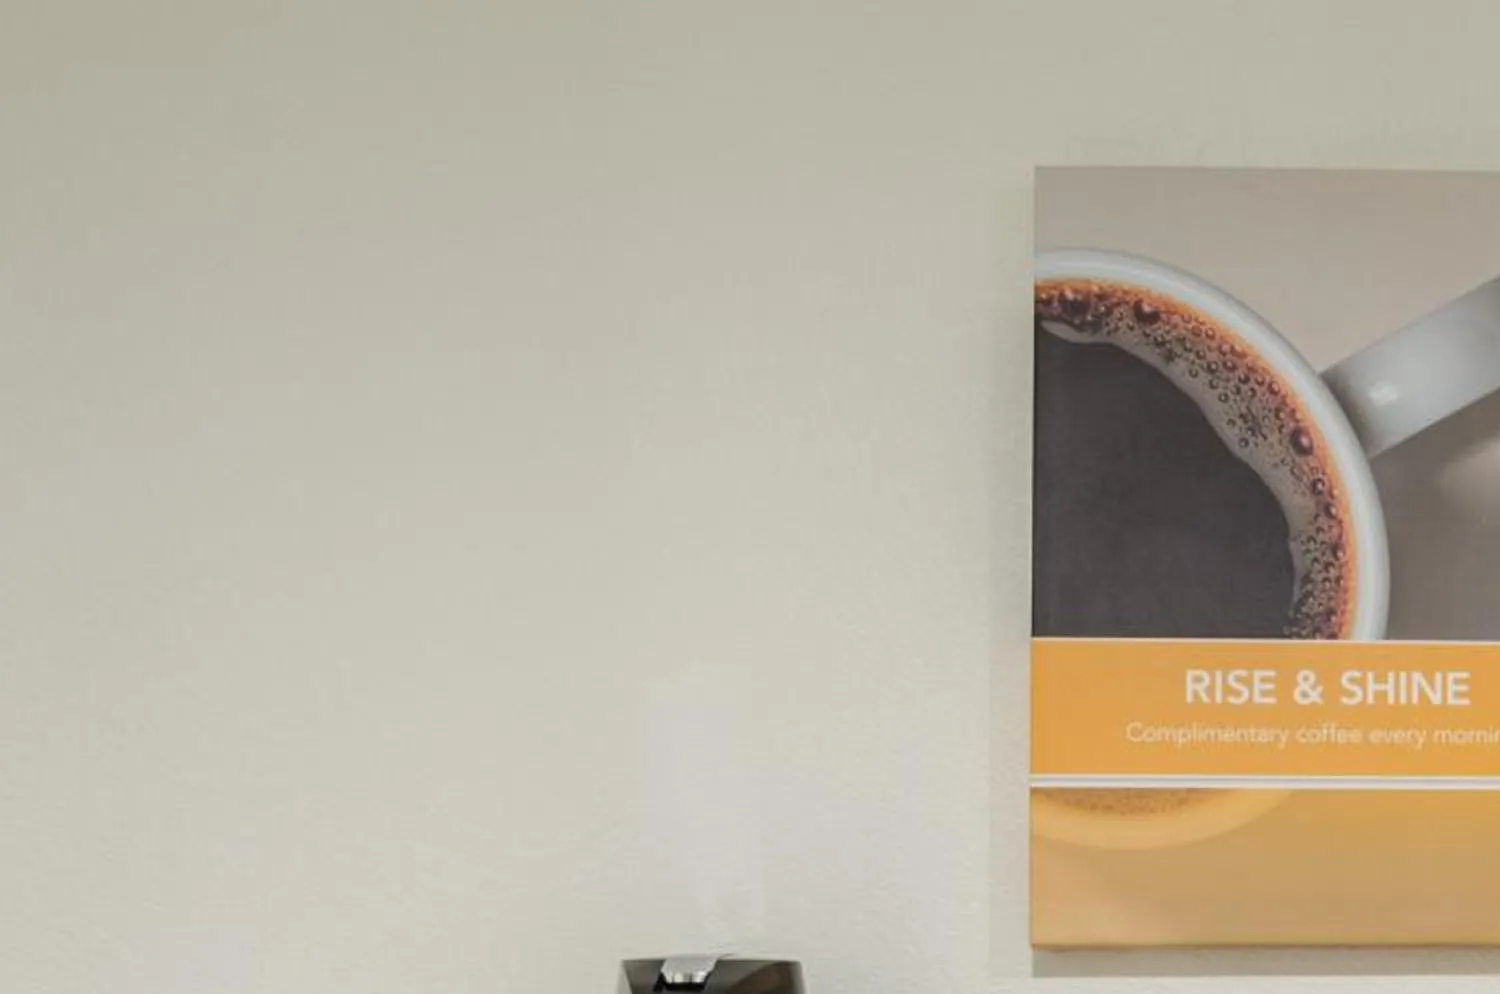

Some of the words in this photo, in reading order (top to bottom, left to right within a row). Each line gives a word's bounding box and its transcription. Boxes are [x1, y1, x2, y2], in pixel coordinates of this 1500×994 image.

[1184, 669, 1278, 705] RISE
[1292, 669, 1324, 706] &
[1340, 670, 1472, 706] SHINE
[1125, 720, 1289, 750] Complimentary
[1295, 722, 1363, 745] coffee
[1368, 728, 1427, 749] every
